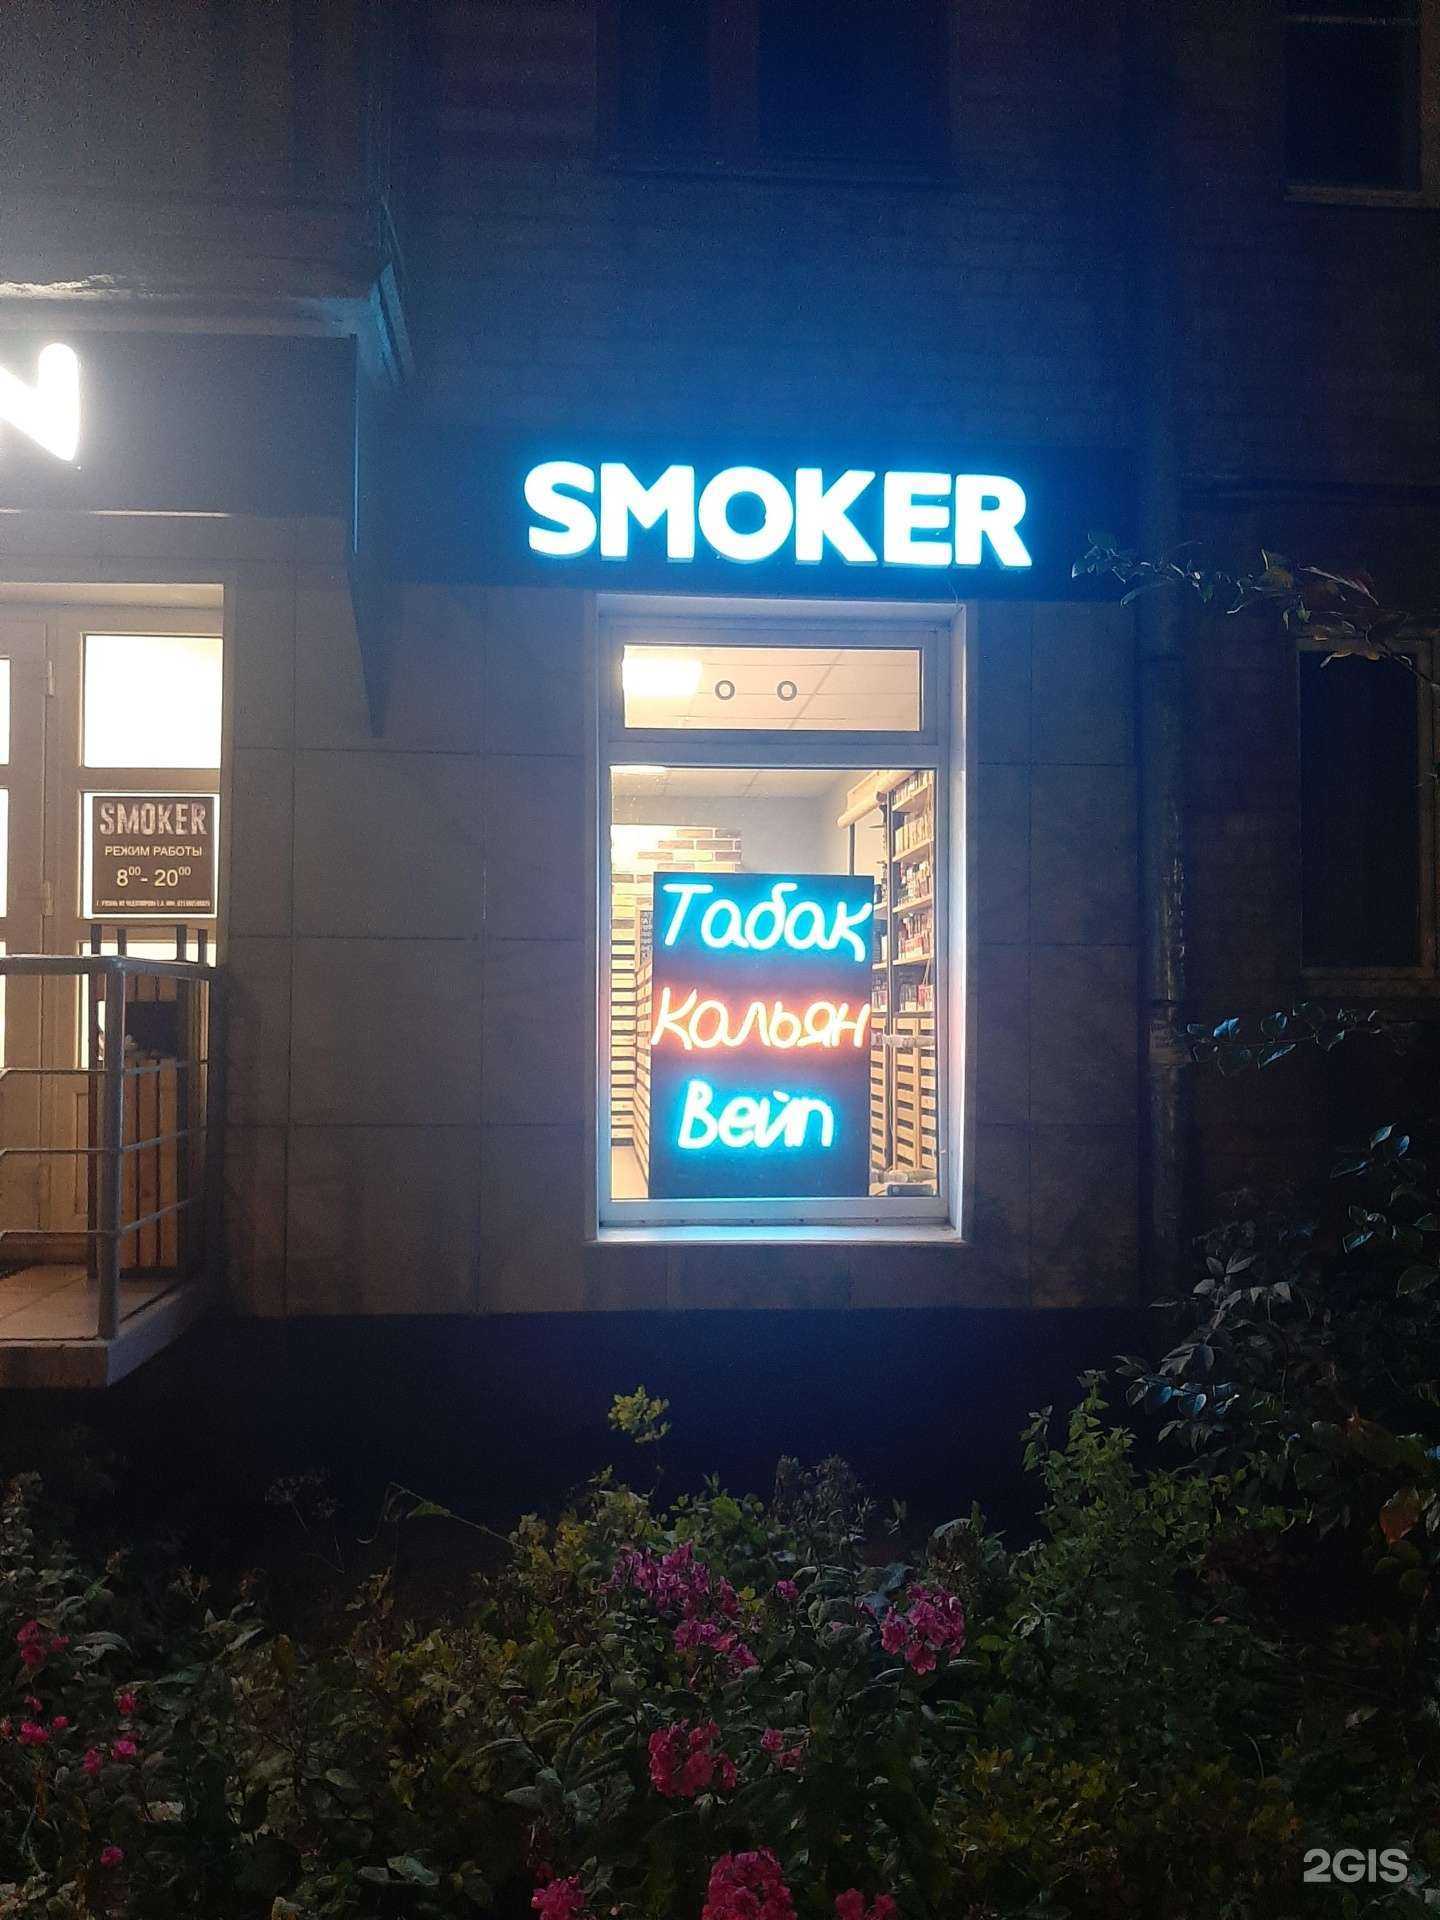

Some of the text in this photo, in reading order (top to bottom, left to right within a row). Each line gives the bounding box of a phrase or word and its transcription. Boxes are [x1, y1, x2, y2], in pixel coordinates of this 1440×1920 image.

[523, 460, 1033, 568] SMOKER
[100, 802, 208, 835] SMOKER
[104, 845, 203, 857] РЕЖИМ РАБОТЫ
[662, 881, 872, 963] Табак
[650, 986, 871, 1051] Кальян
[677, 1079, 835, 1149] Вейп
